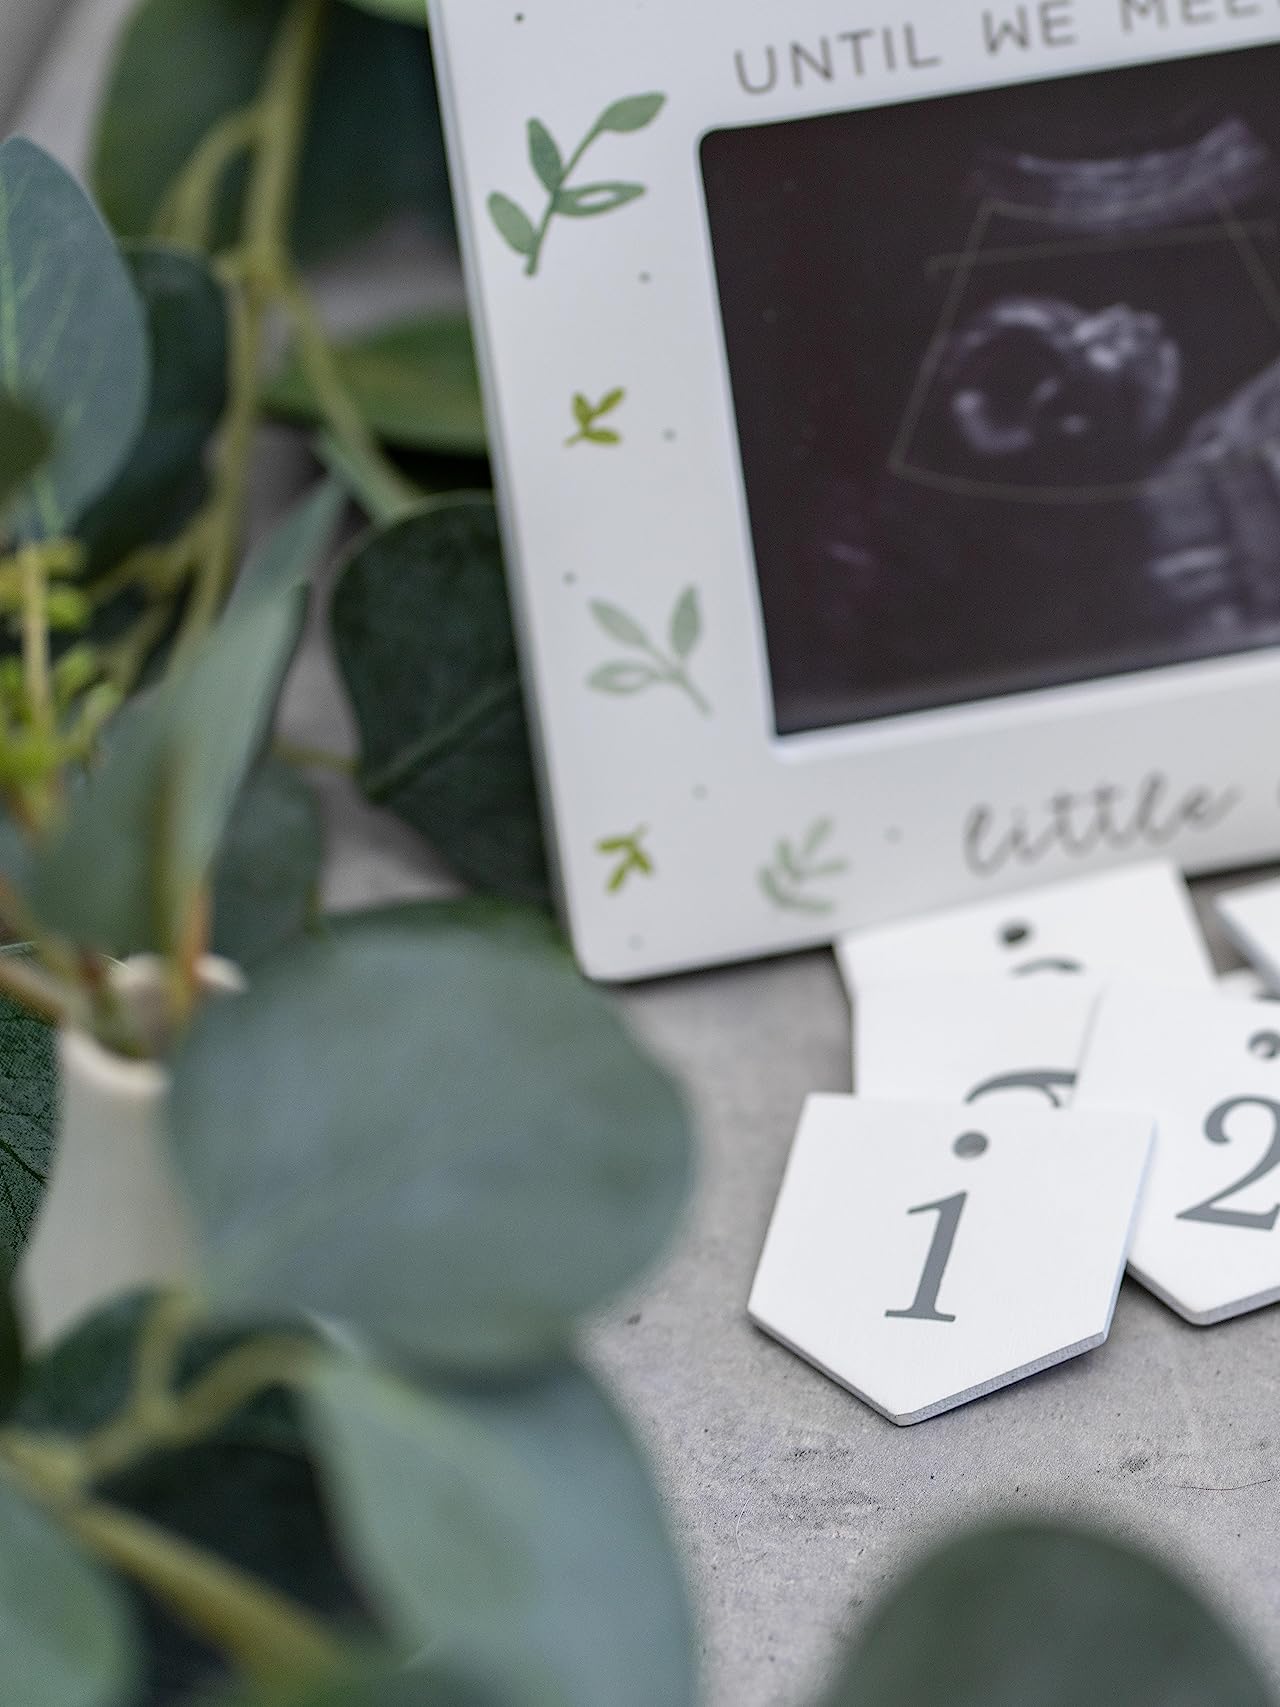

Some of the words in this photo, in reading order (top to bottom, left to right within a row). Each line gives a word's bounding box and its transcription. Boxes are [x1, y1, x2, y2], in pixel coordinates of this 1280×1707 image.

[733, 21, 942, 94] UNTIL
[980, 0, 1077, 56] WE
[963, 766, 1243, 876] little
[883, 1190, 969, 1323] 1
